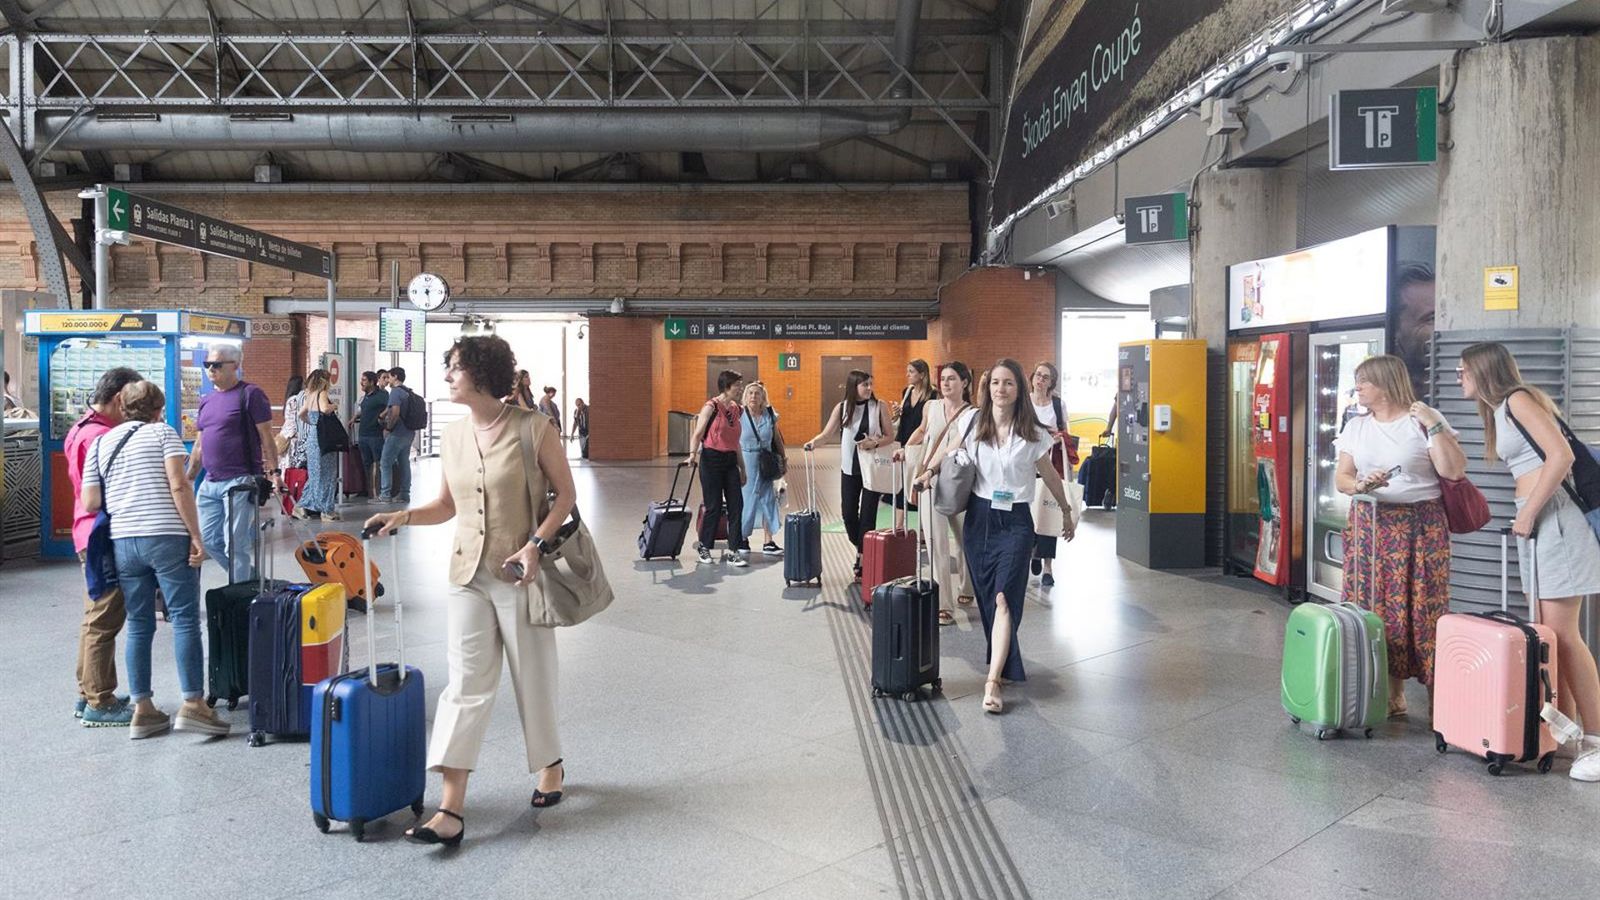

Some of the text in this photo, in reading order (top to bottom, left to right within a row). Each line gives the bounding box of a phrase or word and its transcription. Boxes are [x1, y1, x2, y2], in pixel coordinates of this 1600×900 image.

[1022, 2, 1142, 158] Škoda Enyaq Coupé
[147, 206, 194, 230] Salidas Planta 1
[210, 224, 229, 239] Salidas
[229, 229, 245, 243] Planta
[855, 323, 881, 331] Atención
[1124, 485, 1141, 501] saba.es
